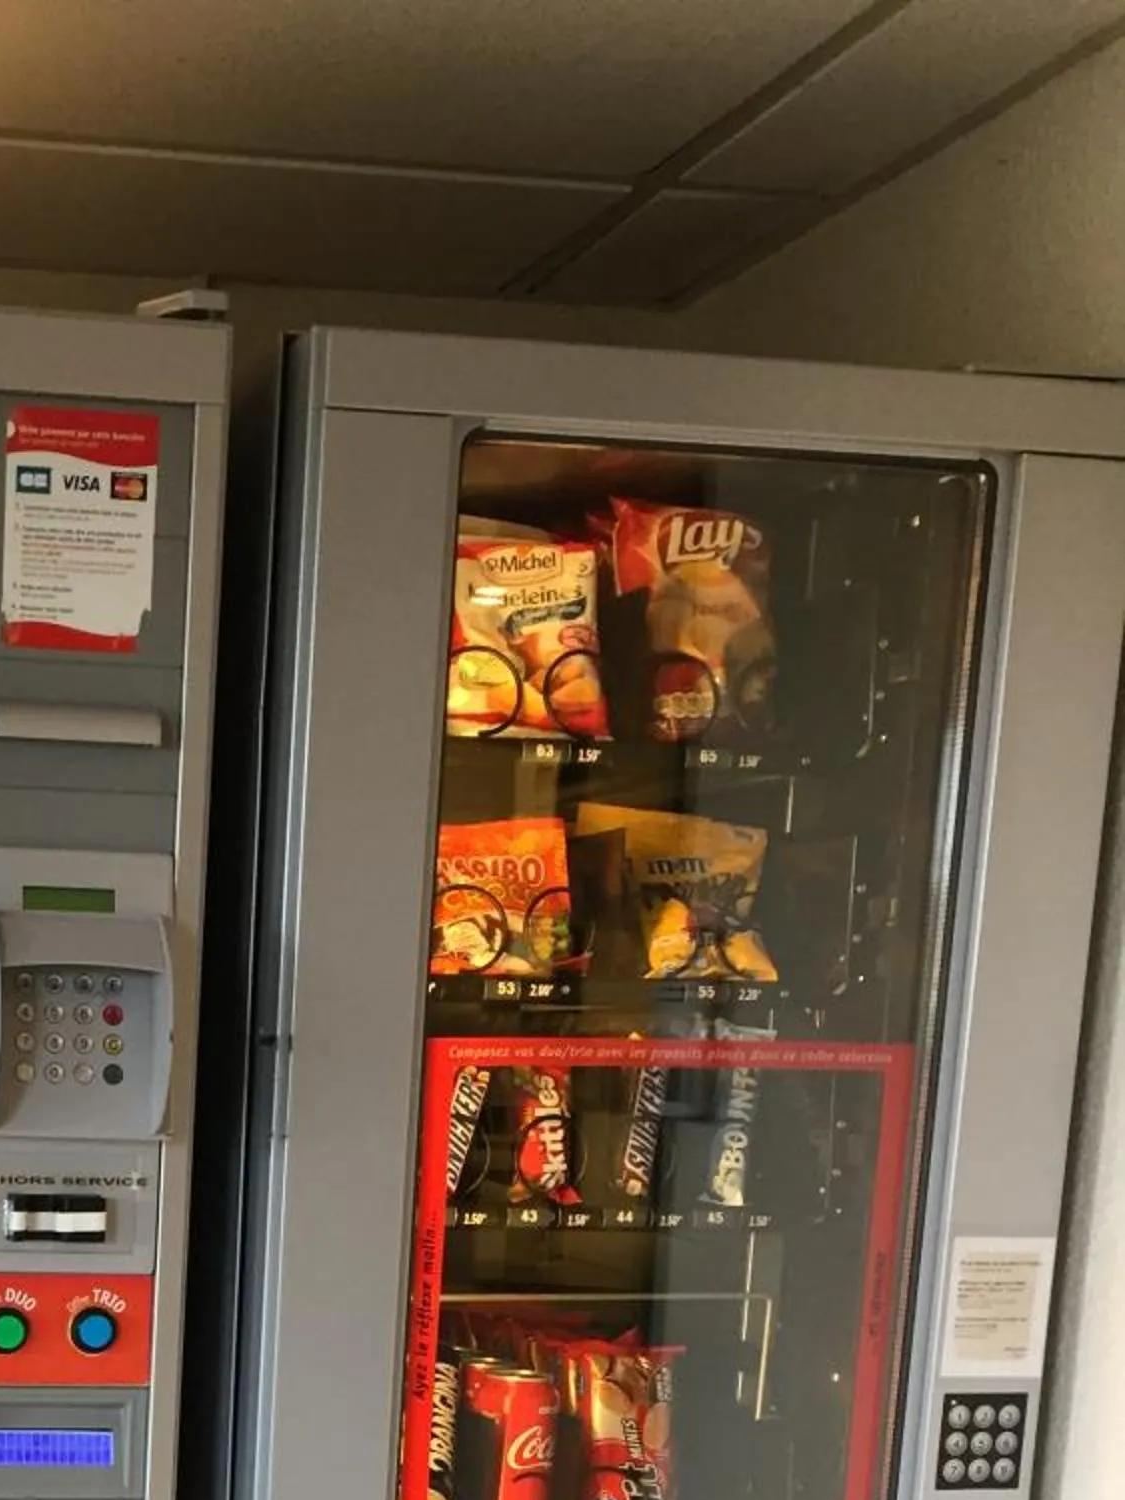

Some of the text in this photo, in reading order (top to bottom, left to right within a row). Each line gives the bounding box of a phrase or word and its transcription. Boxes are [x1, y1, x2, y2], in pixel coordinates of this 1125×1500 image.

[63, 475, 100, 491] VISA
[500, 552, 557, 573] Michel
[723, 1066, 759, 1171] BOUNT
[0, 1174, 55, 1186] HORS
[62, 1174, 148, 1188] SERVICE
[4, 1287, 36, 1312] DUO
[91, 1287, 127, 1313] TRIO
[428, 1361, 459, 1472] ORANGINA
